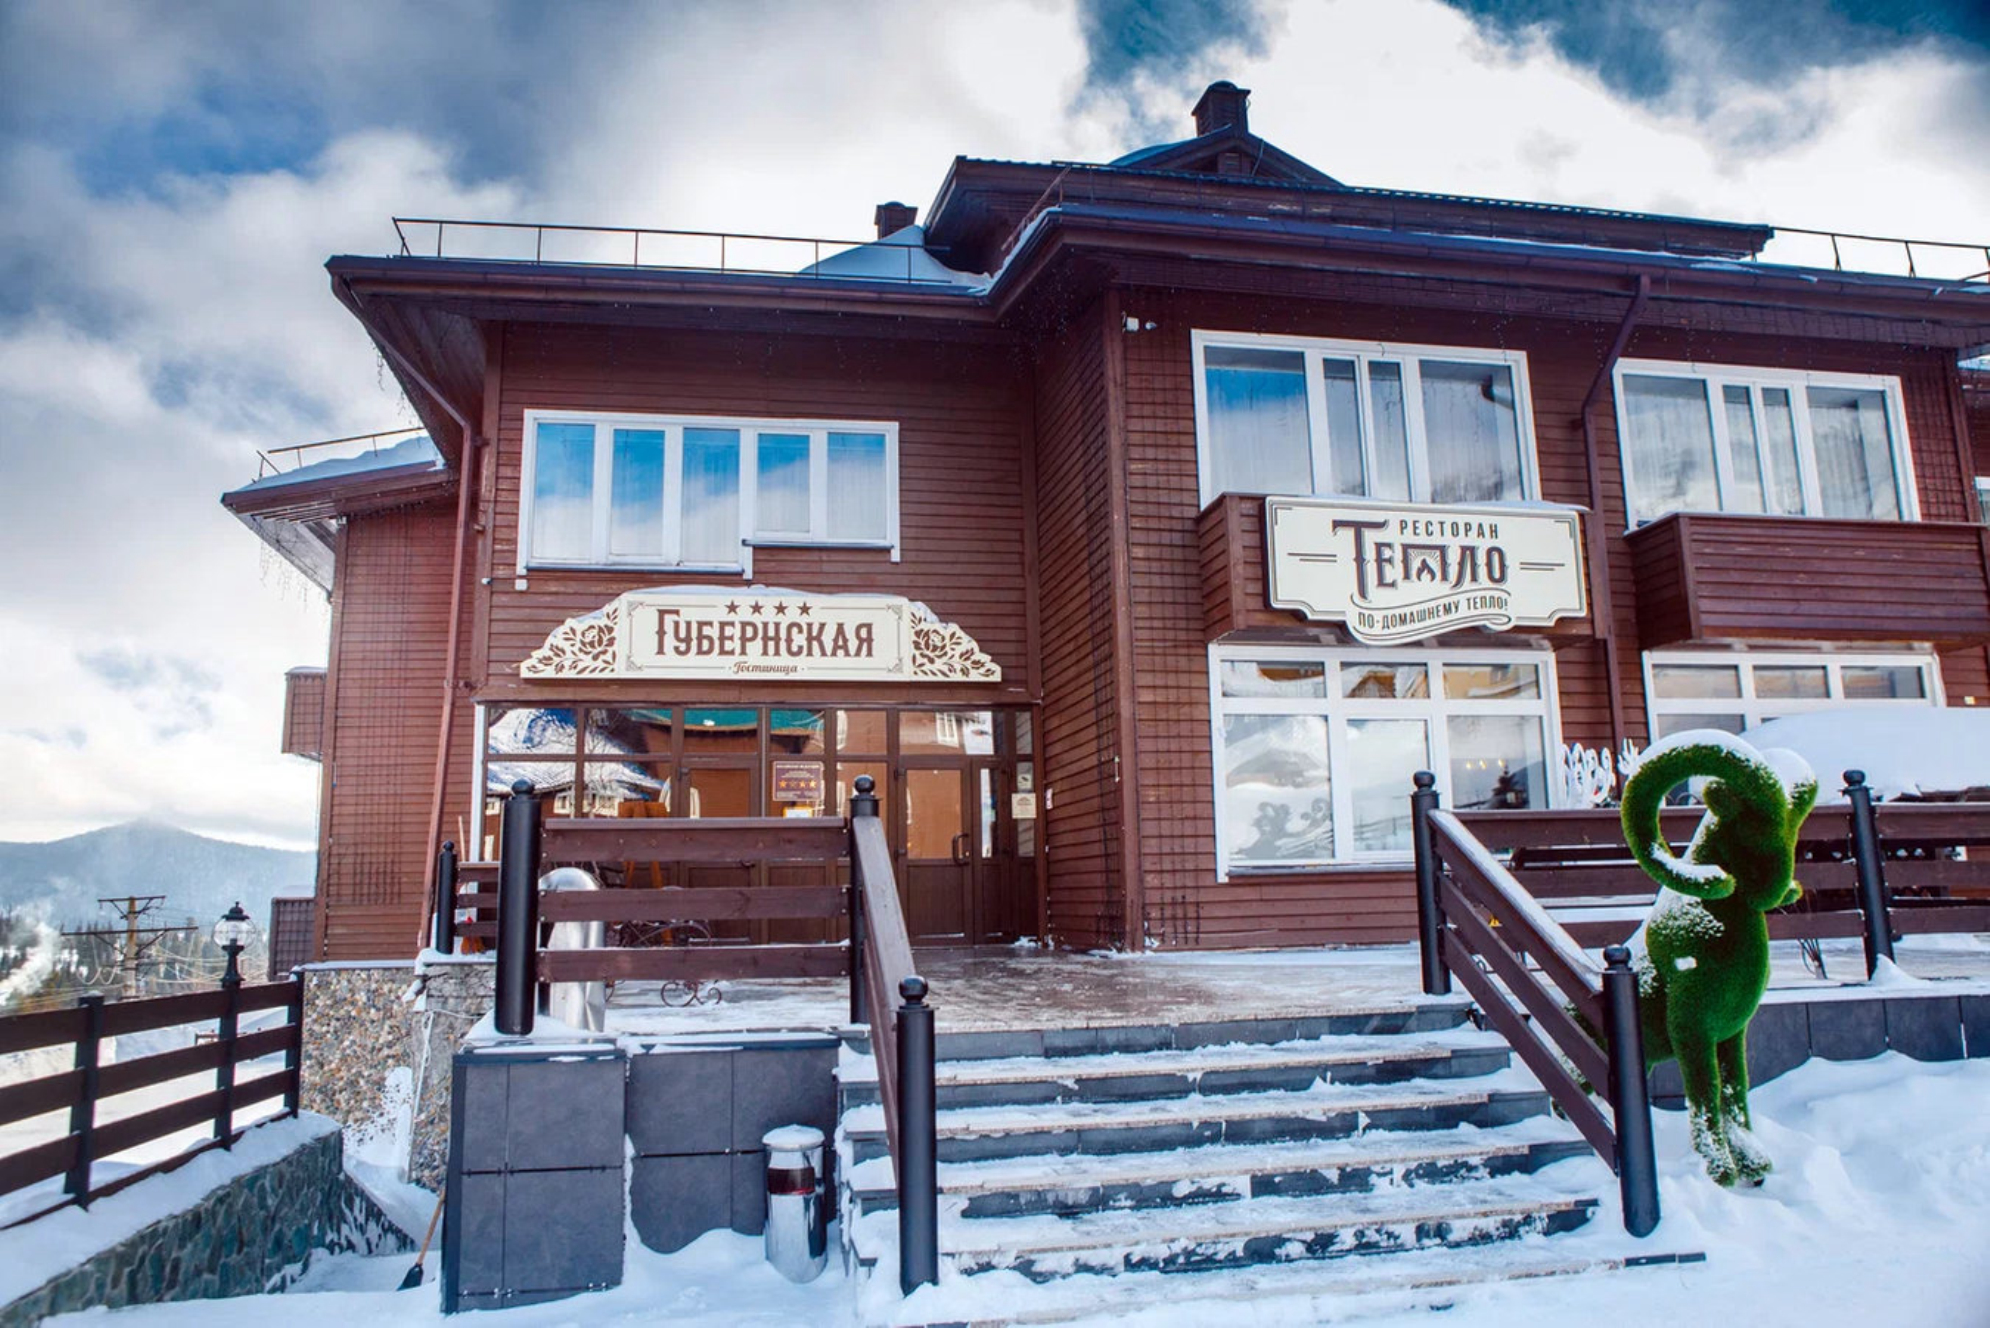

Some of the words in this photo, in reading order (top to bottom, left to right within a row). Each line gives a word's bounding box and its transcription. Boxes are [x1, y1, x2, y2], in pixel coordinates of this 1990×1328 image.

[1400, 519, 1499, 540] РЕСТОРАН
[1358, 600, 1460, 630] ПО-ДОМАШНЕМУ
[1466, 595, 1508, 612] ТЕПЛО!
[655, 609, 873, 658] ГУБЕРНСКАЯ
[733, 661, 798, 675] Гостиница
